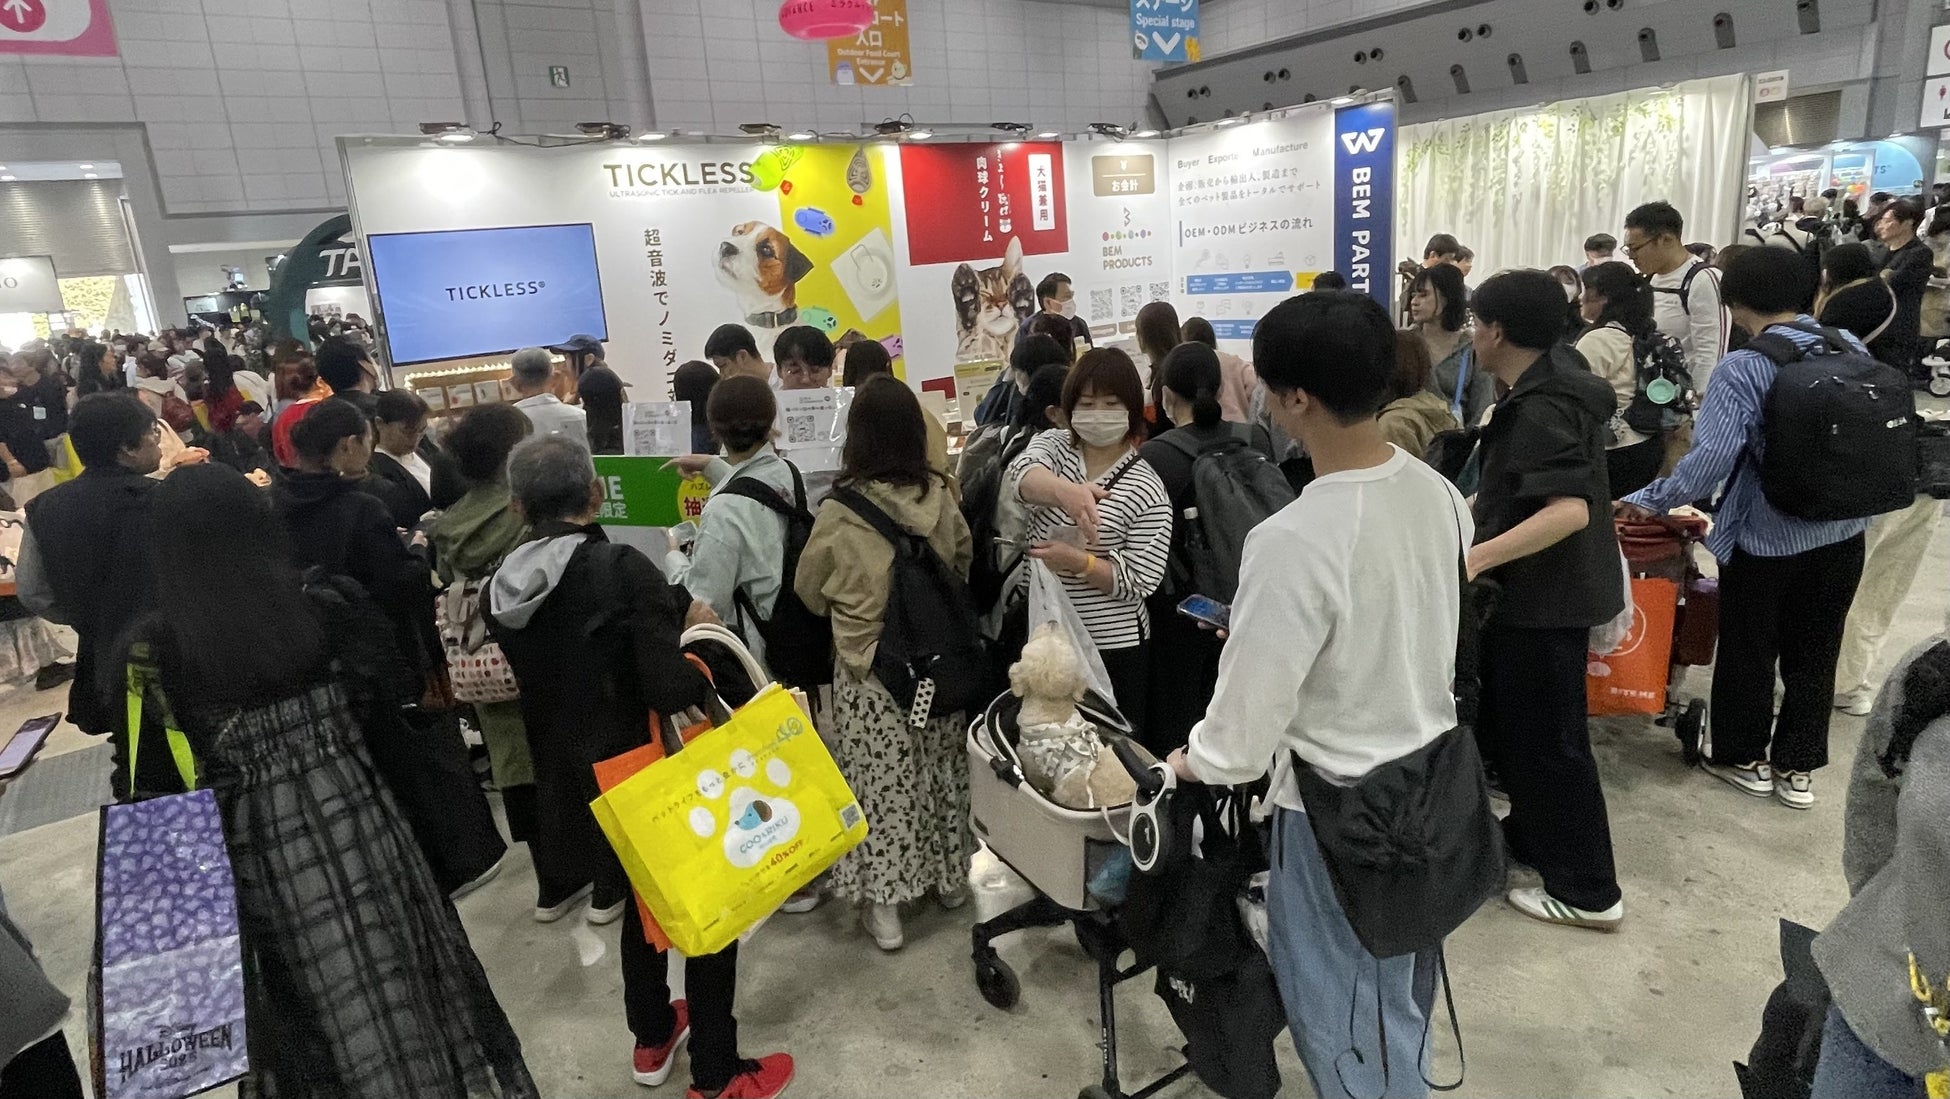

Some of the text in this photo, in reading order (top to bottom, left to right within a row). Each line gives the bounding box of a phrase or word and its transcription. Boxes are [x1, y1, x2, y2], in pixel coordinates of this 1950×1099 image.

[1136, 13, 1195, 31] Special stage
[856, 30, 882, 46] 入口
[837, 48, 865, 56] Outdoor
[1177, 158, 1200, 170] Buyer
[603, 162, 755, 187] TICKLESS
[1111, 179, 1139, 192] お会計
[1352, 167, 1371, 219] BEM
[609, 189, 660, 198] ULTRASONIC
[976, 156, 993, 242] 肉球クリーム
[1102, 245, 1122, 257] BEM
[1103, 256, 1153, 271] PRODUCTS
[120, 1022, 234, 1083] HALLOWEEN
